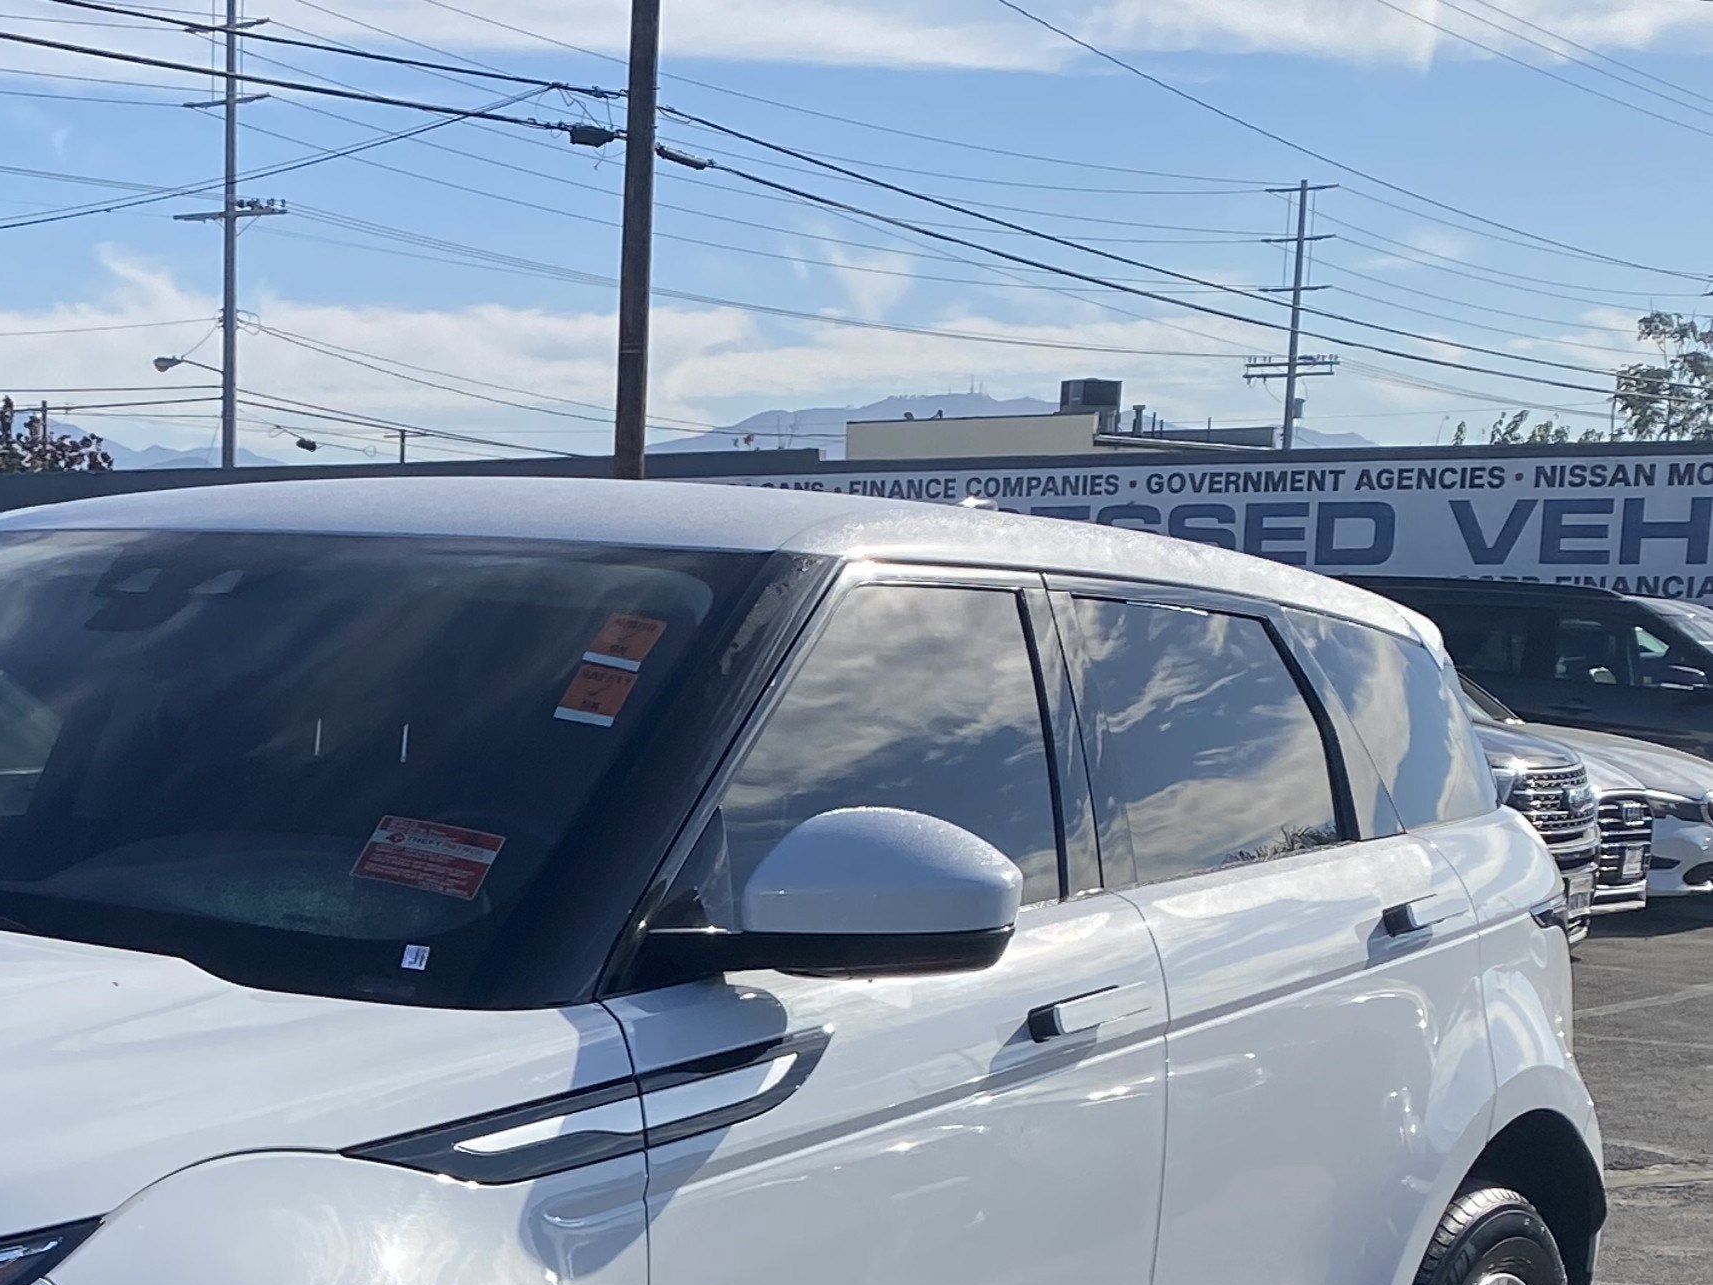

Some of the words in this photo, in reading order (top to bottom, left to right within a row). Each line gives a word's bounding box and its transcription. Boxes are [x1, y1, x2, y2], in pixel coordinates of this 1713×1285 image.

[848, 477, 957, 499] FINANCE
[965, 474, 1120, 498] COMPANIES
[1145, 468, 1346, 494] GOVERNMENT
[1354, 465, 1506, 491] AGENCIES
[1533, 463, 1657, 489] NISSAN
